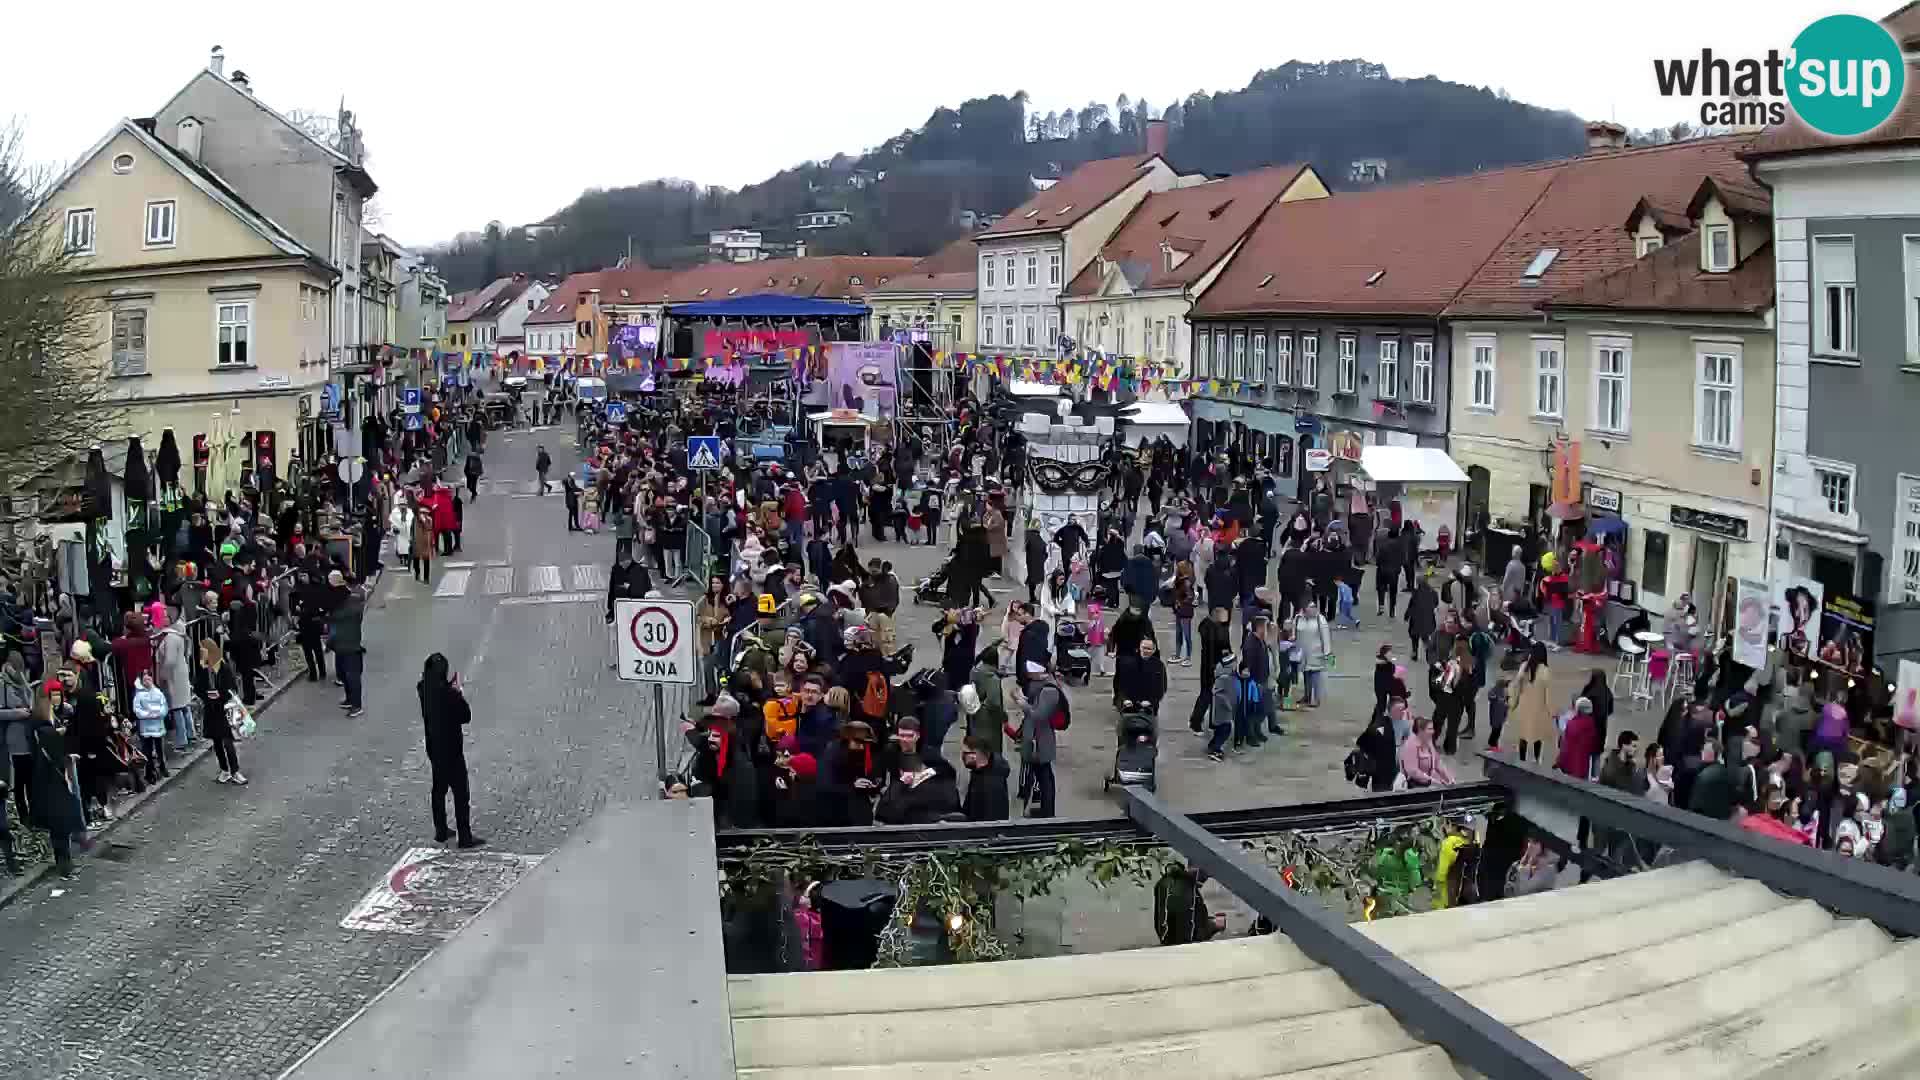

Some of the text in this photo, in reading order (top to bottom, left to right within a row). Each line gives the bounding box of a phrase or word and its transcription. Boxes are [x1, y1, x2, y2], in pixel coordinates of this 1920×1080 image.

[407, 391, 416, 404] P
[643, 622, 667, 643] 30
[634, 659, 677, 676] ZONA
